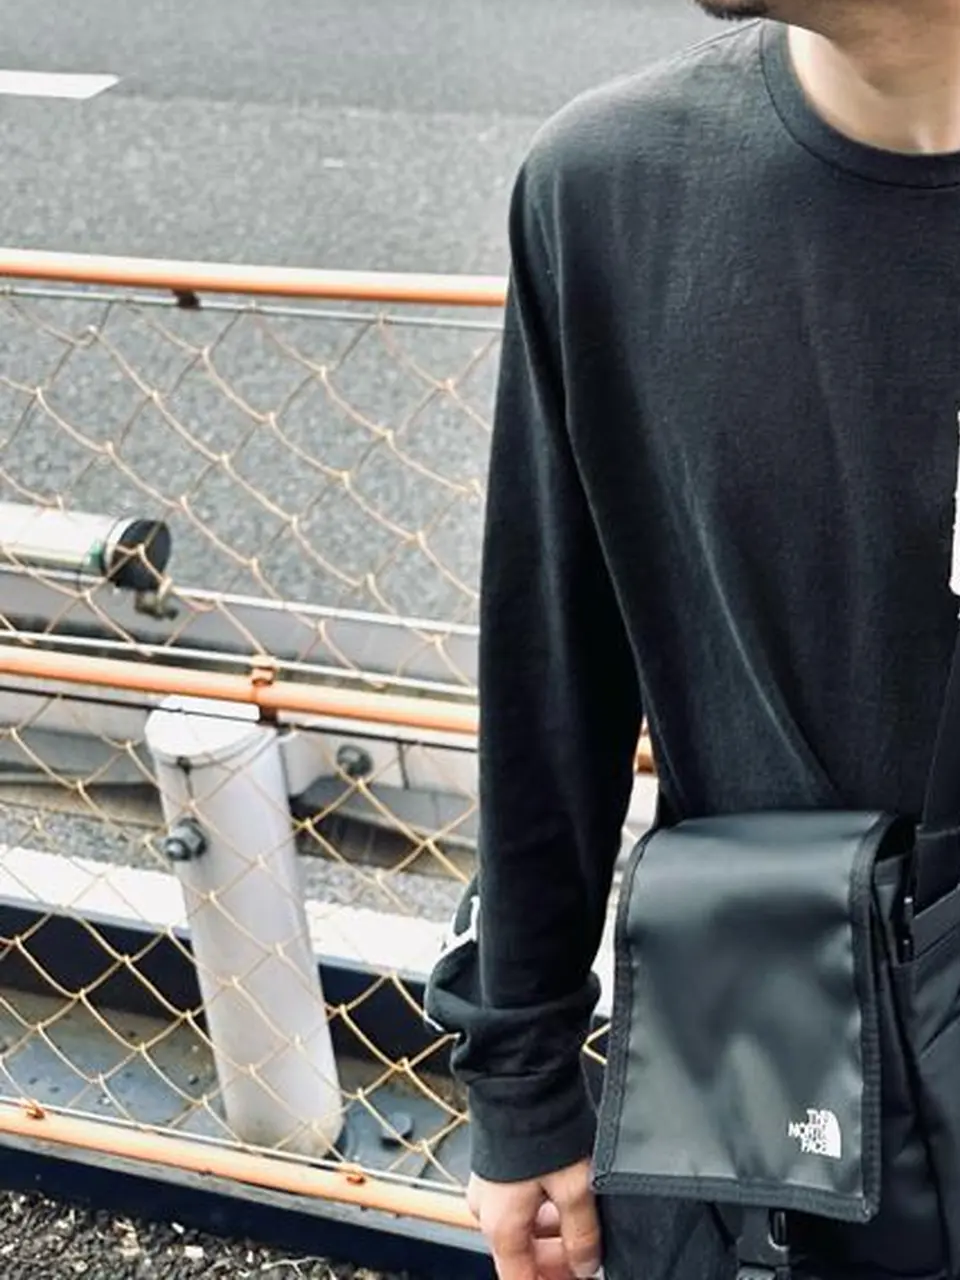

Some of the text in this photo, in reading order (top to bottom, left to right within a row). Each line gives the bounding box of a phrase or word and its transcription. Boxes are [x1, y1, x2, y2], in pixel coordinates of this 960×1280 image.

[806, 1108, 829, 1126] THE
[788, 1122, 828, 1141] NORTH
[801, 1138, 828, 1155] FACE
